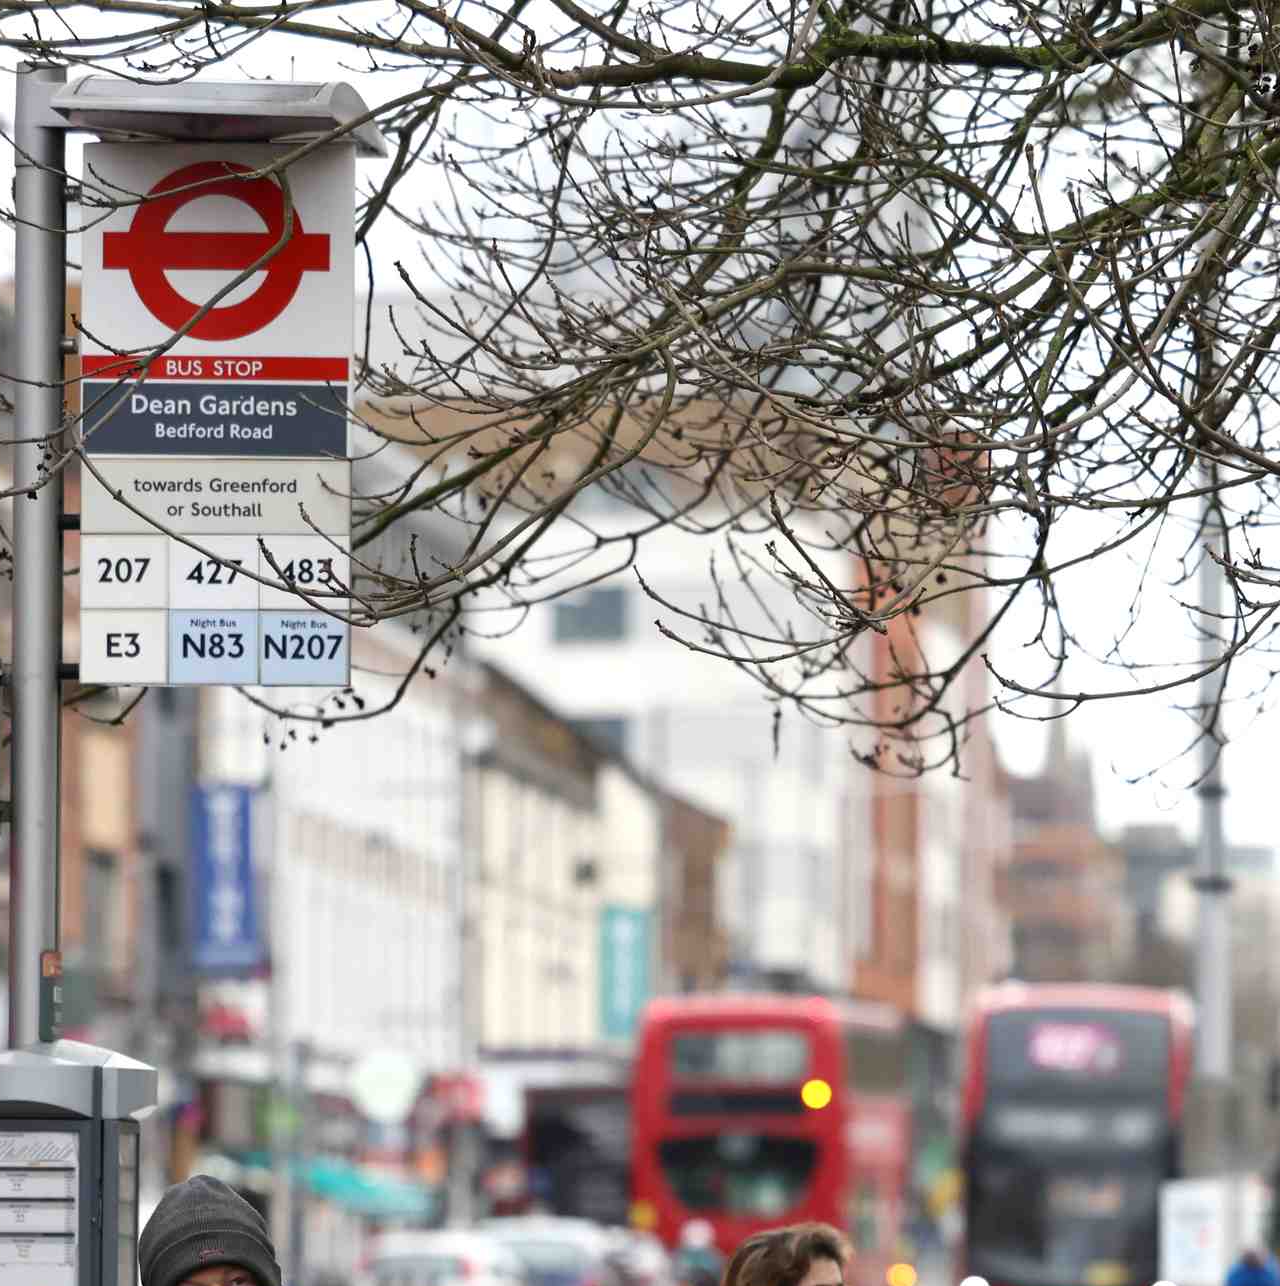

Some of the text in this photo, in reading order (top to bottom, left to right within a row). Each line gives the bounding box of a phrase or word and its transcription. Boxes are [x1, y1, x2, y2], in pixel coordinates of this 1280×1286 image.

[166, 360, 263, 377] BUS STOP
[131, 394, 297, 417] Dean Gardens
[155, 422, 273, 440] Bedford Road
[133, 477, 297, 494] towards Greenford
[166, 501, 263, 518] or Southall
[97, 557, 151, 583] 207
[186, 559, 242, 585] 427
[278, 558, 334, 583] 483
[190, 618, 237, 628] Night Bus
[280, 619, 328, 629] Night Bus
[106, 632, 141, 658] E3
[182, 633, 244, 659] N83
[264, 634, 344, 660] N207
